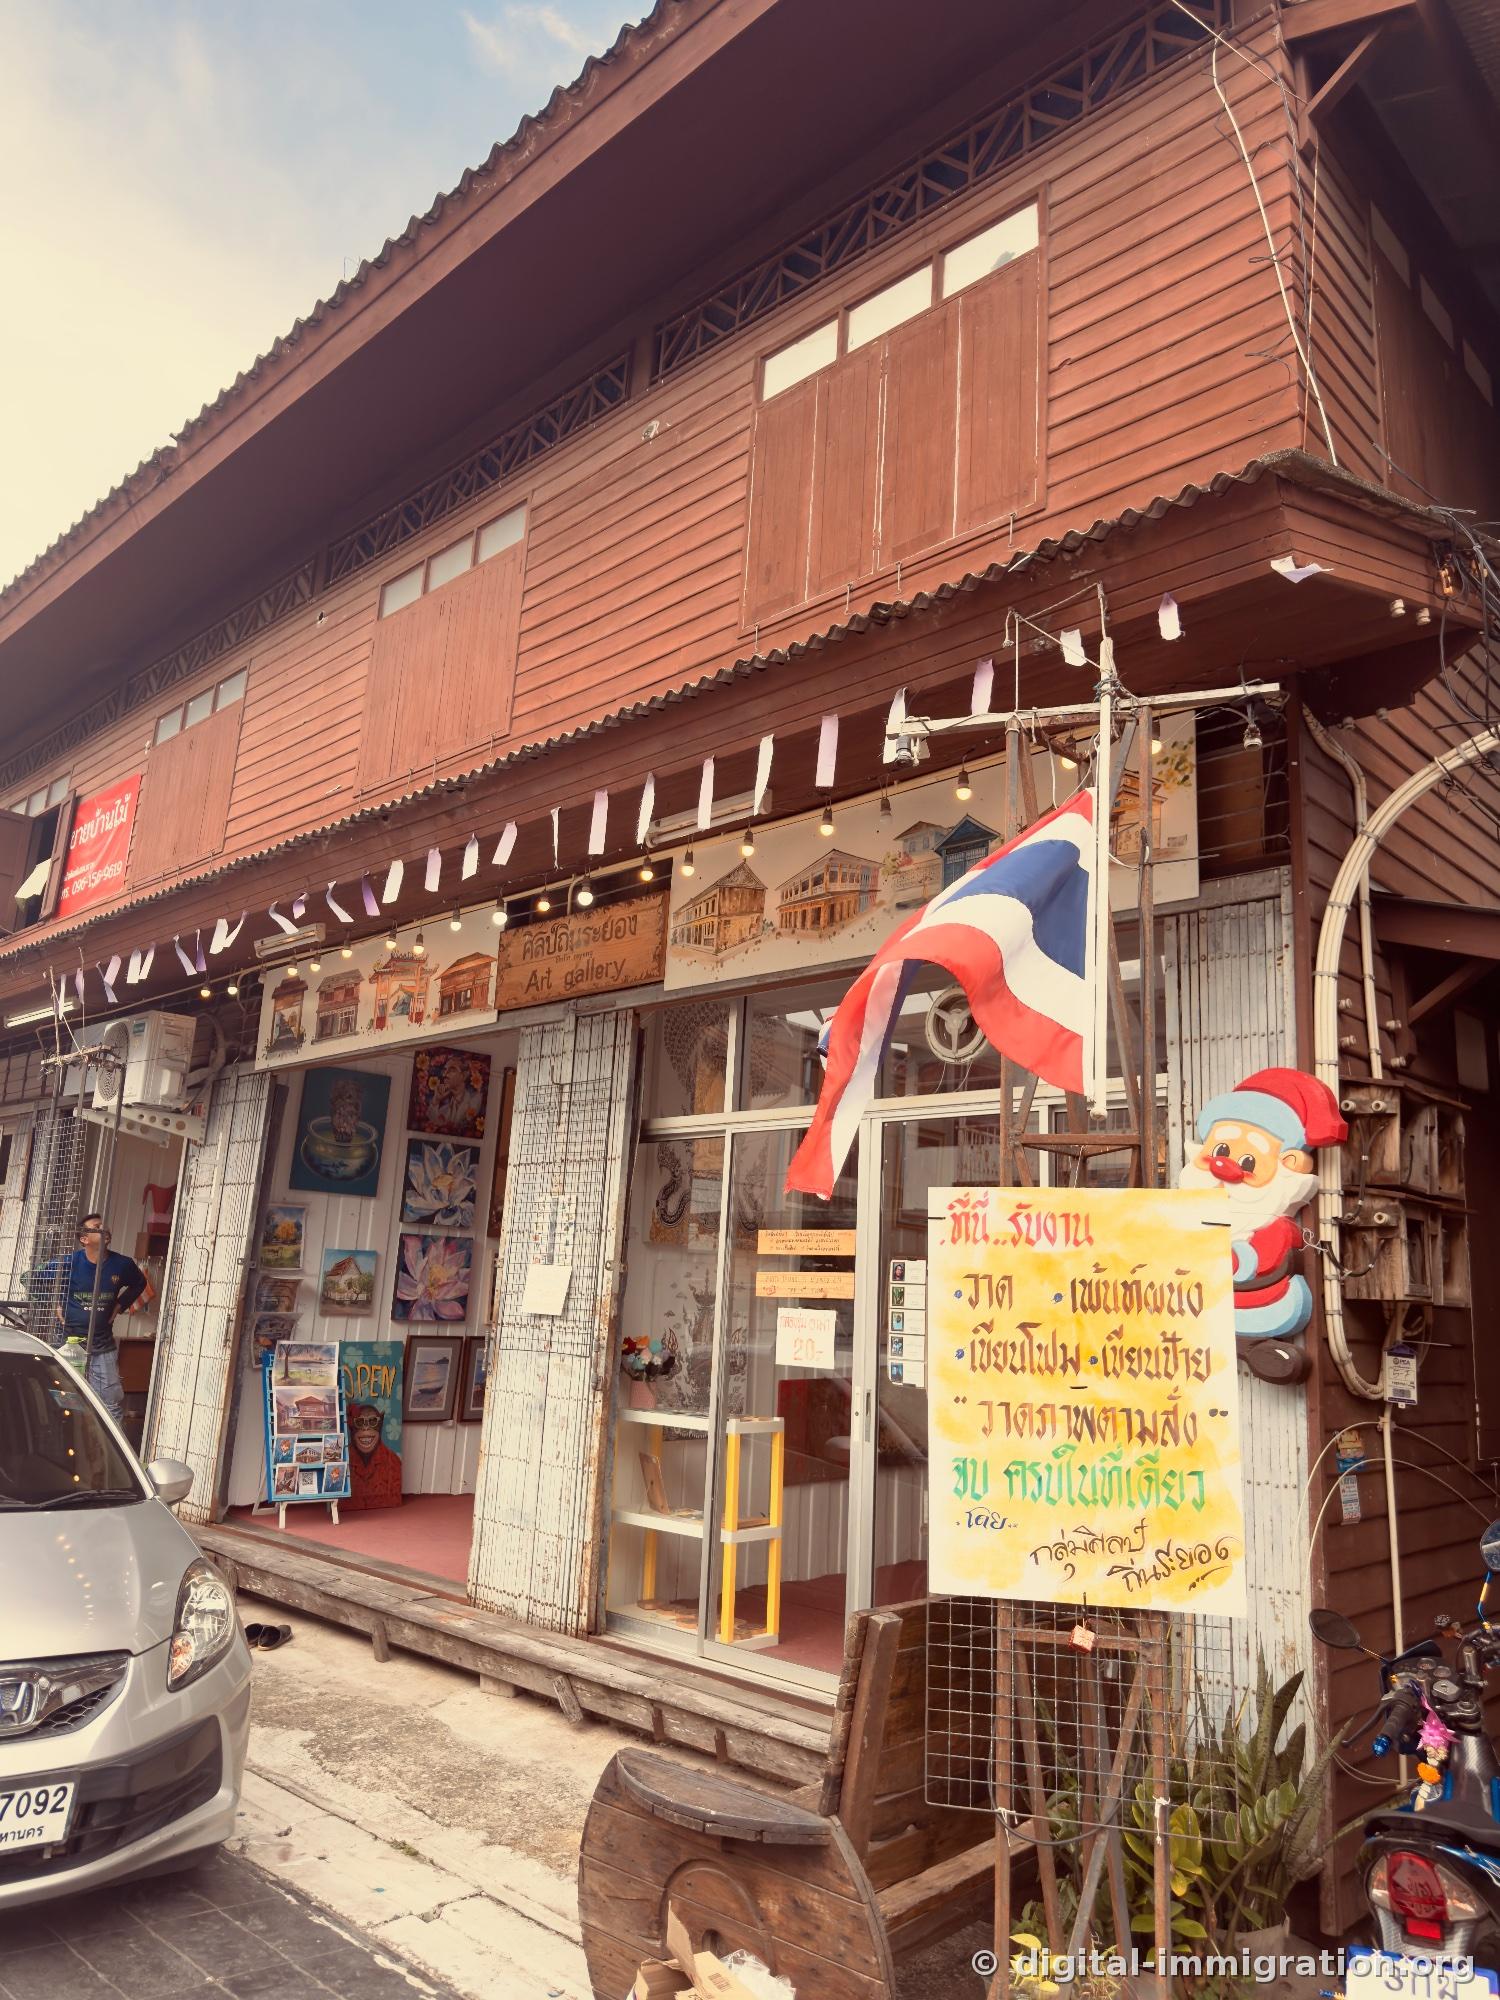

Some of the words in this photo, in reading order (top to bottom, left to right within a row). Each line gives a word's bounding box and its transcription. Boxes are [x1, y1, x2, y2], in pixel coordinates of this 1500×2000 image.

[525, 966, 552, 994] Art
[564, 958, 626, 991] gallery
[0, 1785, 68, 1821] 7092
